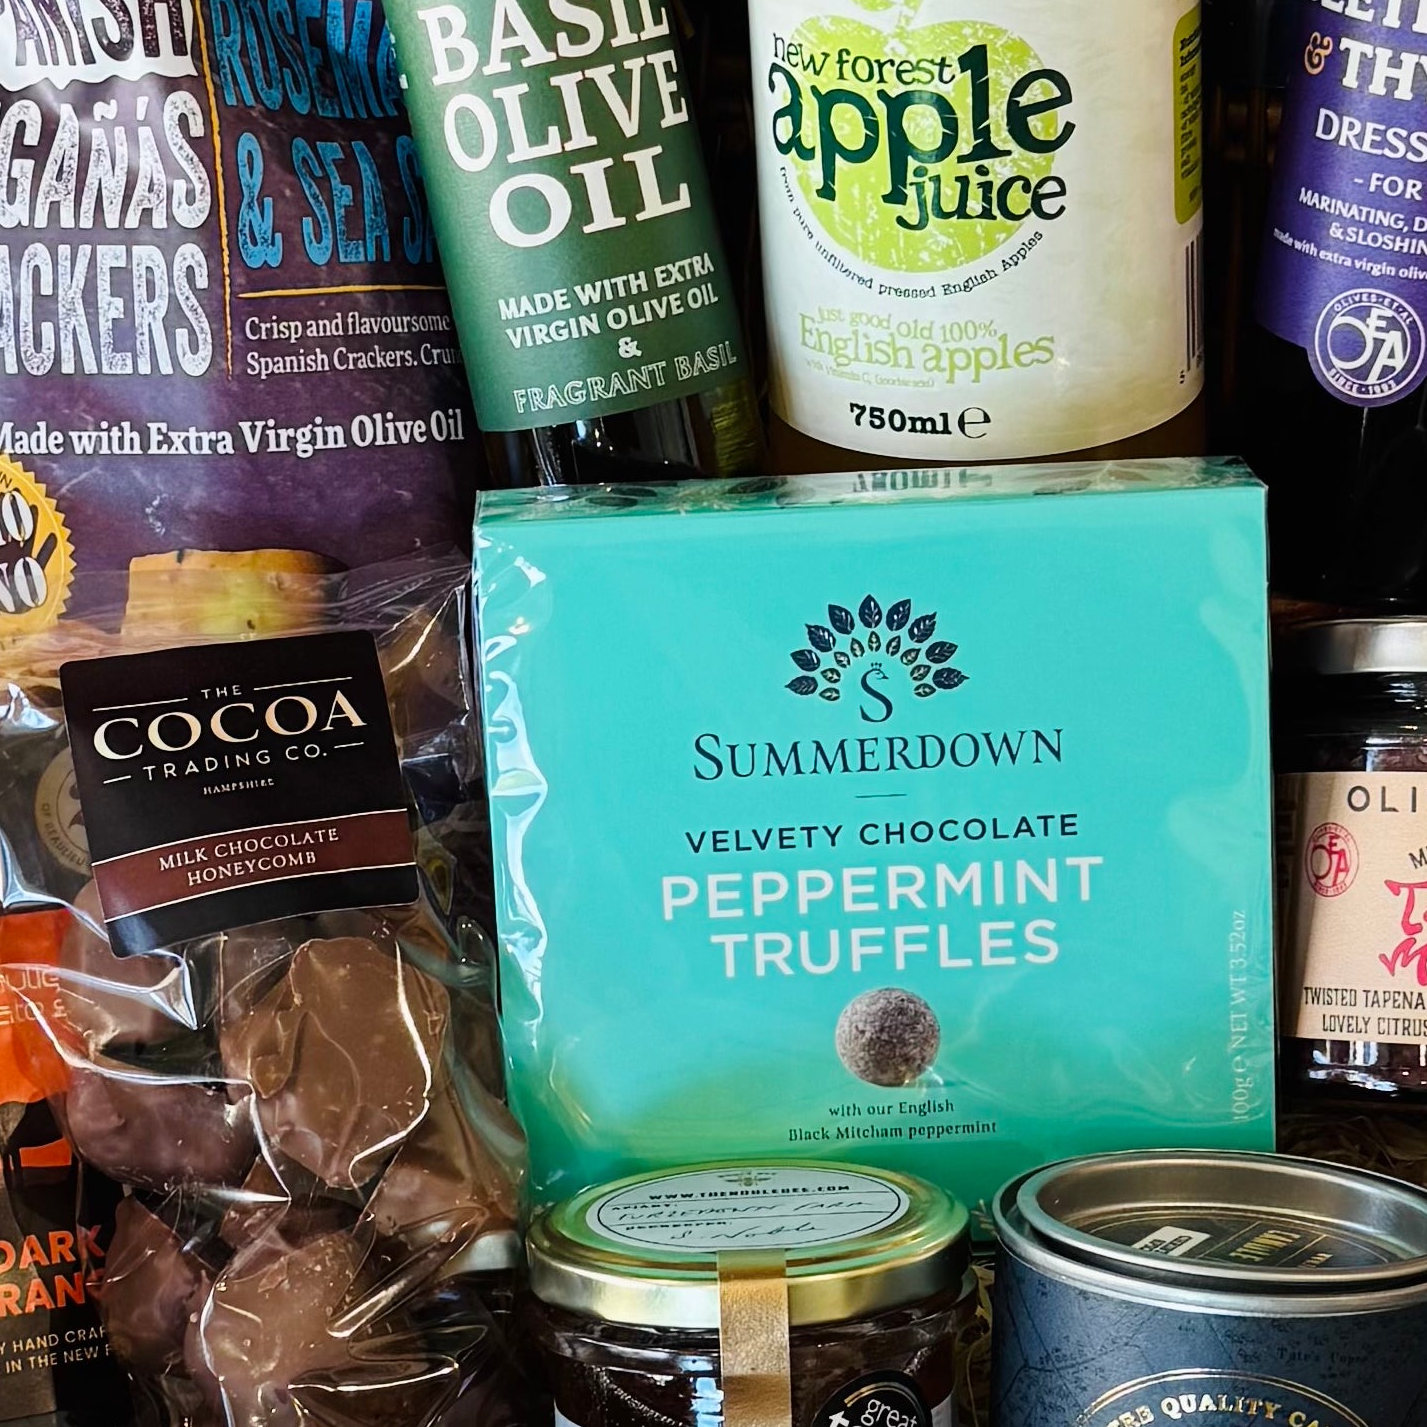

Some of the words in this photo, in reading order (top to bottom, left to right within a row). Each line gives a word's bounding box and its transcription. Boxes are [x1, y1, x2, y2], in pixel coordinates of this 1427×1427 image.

[772, 32, 830, 74] new
[836, 49, 955, 86] forest
[1304, 32, 1333, 75] &
[443, 48, 689, 173] OLIVE
[767, 44, 1076, 205] apple
[488, 144, 692, 248] OIL
[896, 164, 1067, 231] juice
[498, 290, 570, 320] MADE
[572, 269, 648, 307] WITH
[653, 252, 714, 287] EXTRA
[69, 421, 143, 455] with
[147, 426, 233, 455] Extra
[240, 421, 346, 459] Virgin
[352, 413, 427, 446] Olive
[430, 409, 464, 442] Oil
[849, 403, 952, 435] 750ml
[693, 728, 1064, 781] SUMMERDOWN
[159, 846, 206, 872] MILK
[214, 827, 339, 859] CHOCOLATE
[686, 825, 843, 854] VELVETY
[859, 813, 1079, 846] CHOCOLATE
[188, 851, 317, 886] HONEYCOMB
[661, 855, 1104, 921] PEPPERMINT
[710, 919, 1060, 980] TRUFFLES
[829, 1103, 862, 1117] with
[867, 1104, 893, 1116] our
[899, 1099, 954, 1116] English
